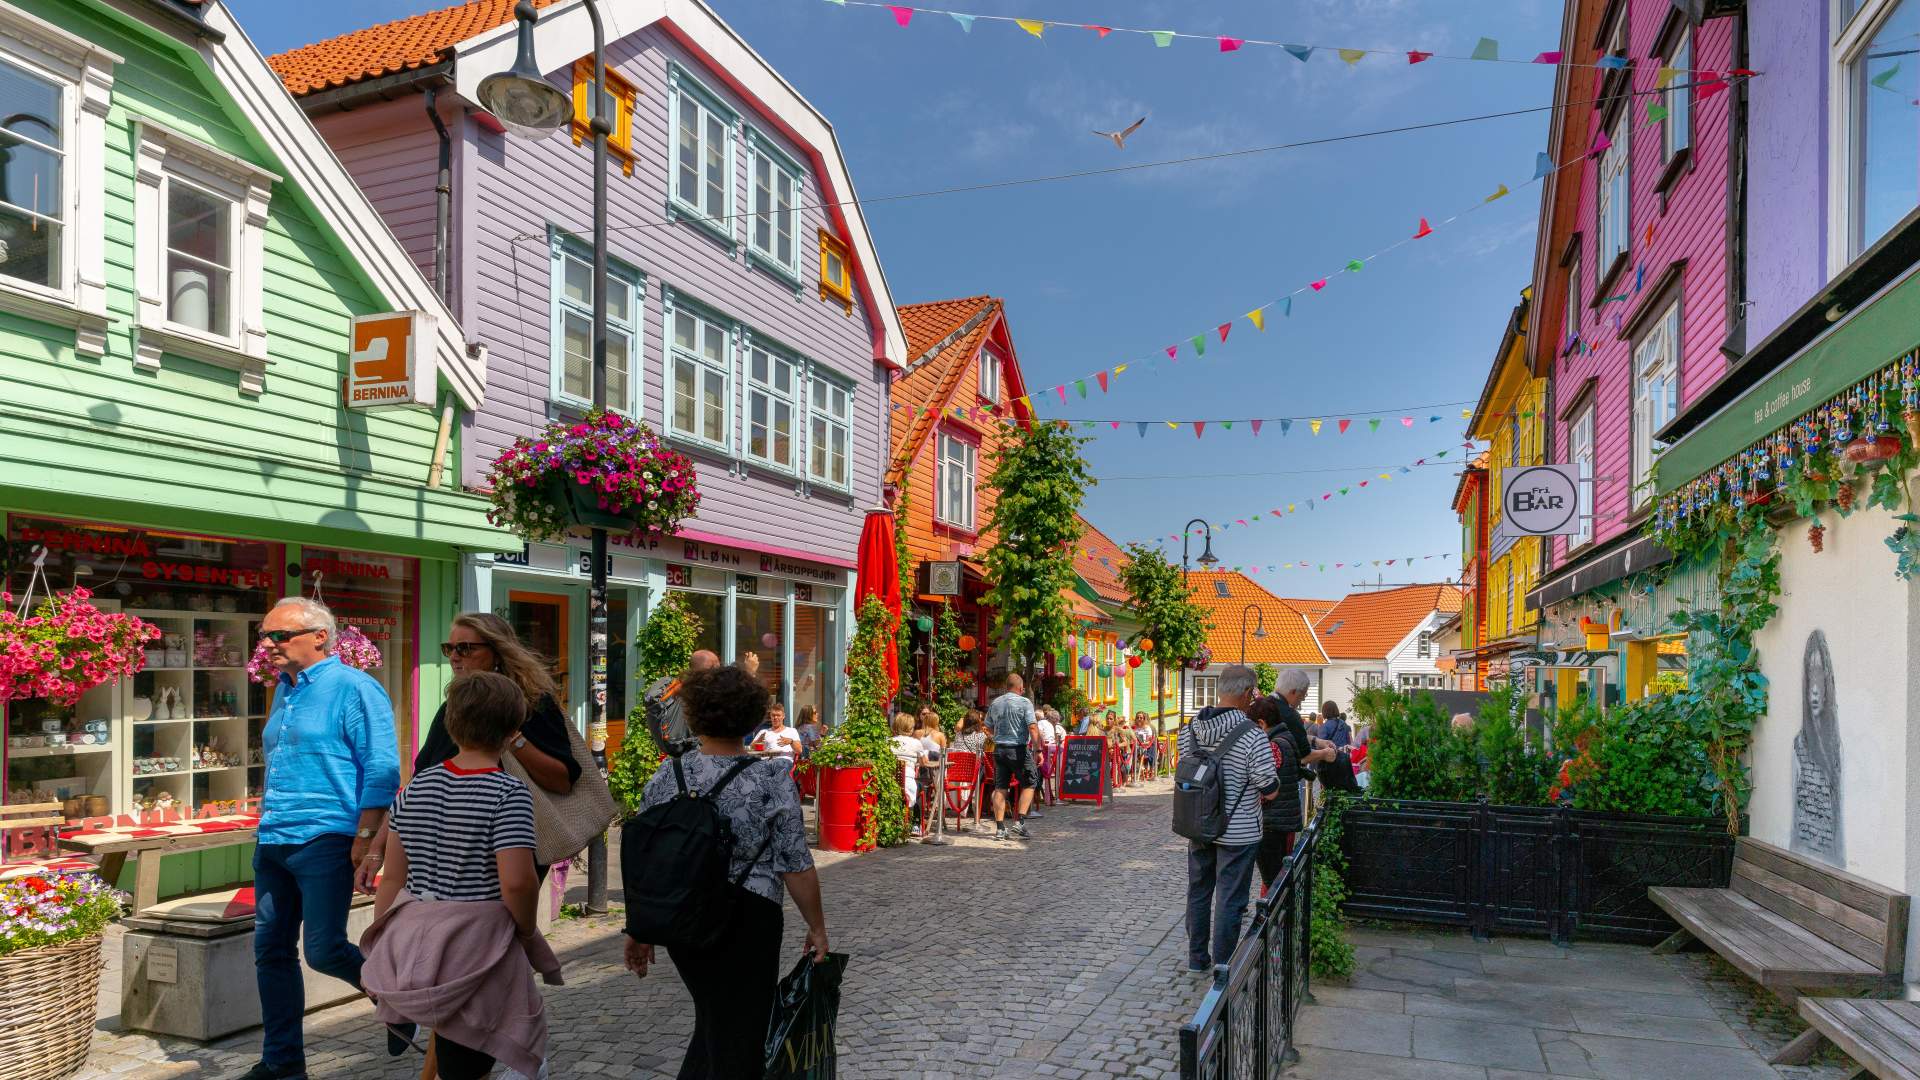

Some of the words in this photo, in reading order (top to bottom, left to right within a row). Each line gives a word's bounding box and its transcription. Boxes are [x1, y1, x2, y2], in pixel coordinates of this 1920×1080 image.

[353, 385, 408, 401] BERNINA
[1754, 409, 1763, 424] tea
[1764, 401, 1770, 418] &
[1770, 391, 1790, 415] coffee
[1791, 378, 1811, 401] house
[1513, 492, 1564, 512] BAR
[21, 527, 150, 558] BERNINA
[701, 551, 740, 566] LØNN
[142, 561, 273, 588] SYSENTER
[666, 567, 690, 586] ecit
